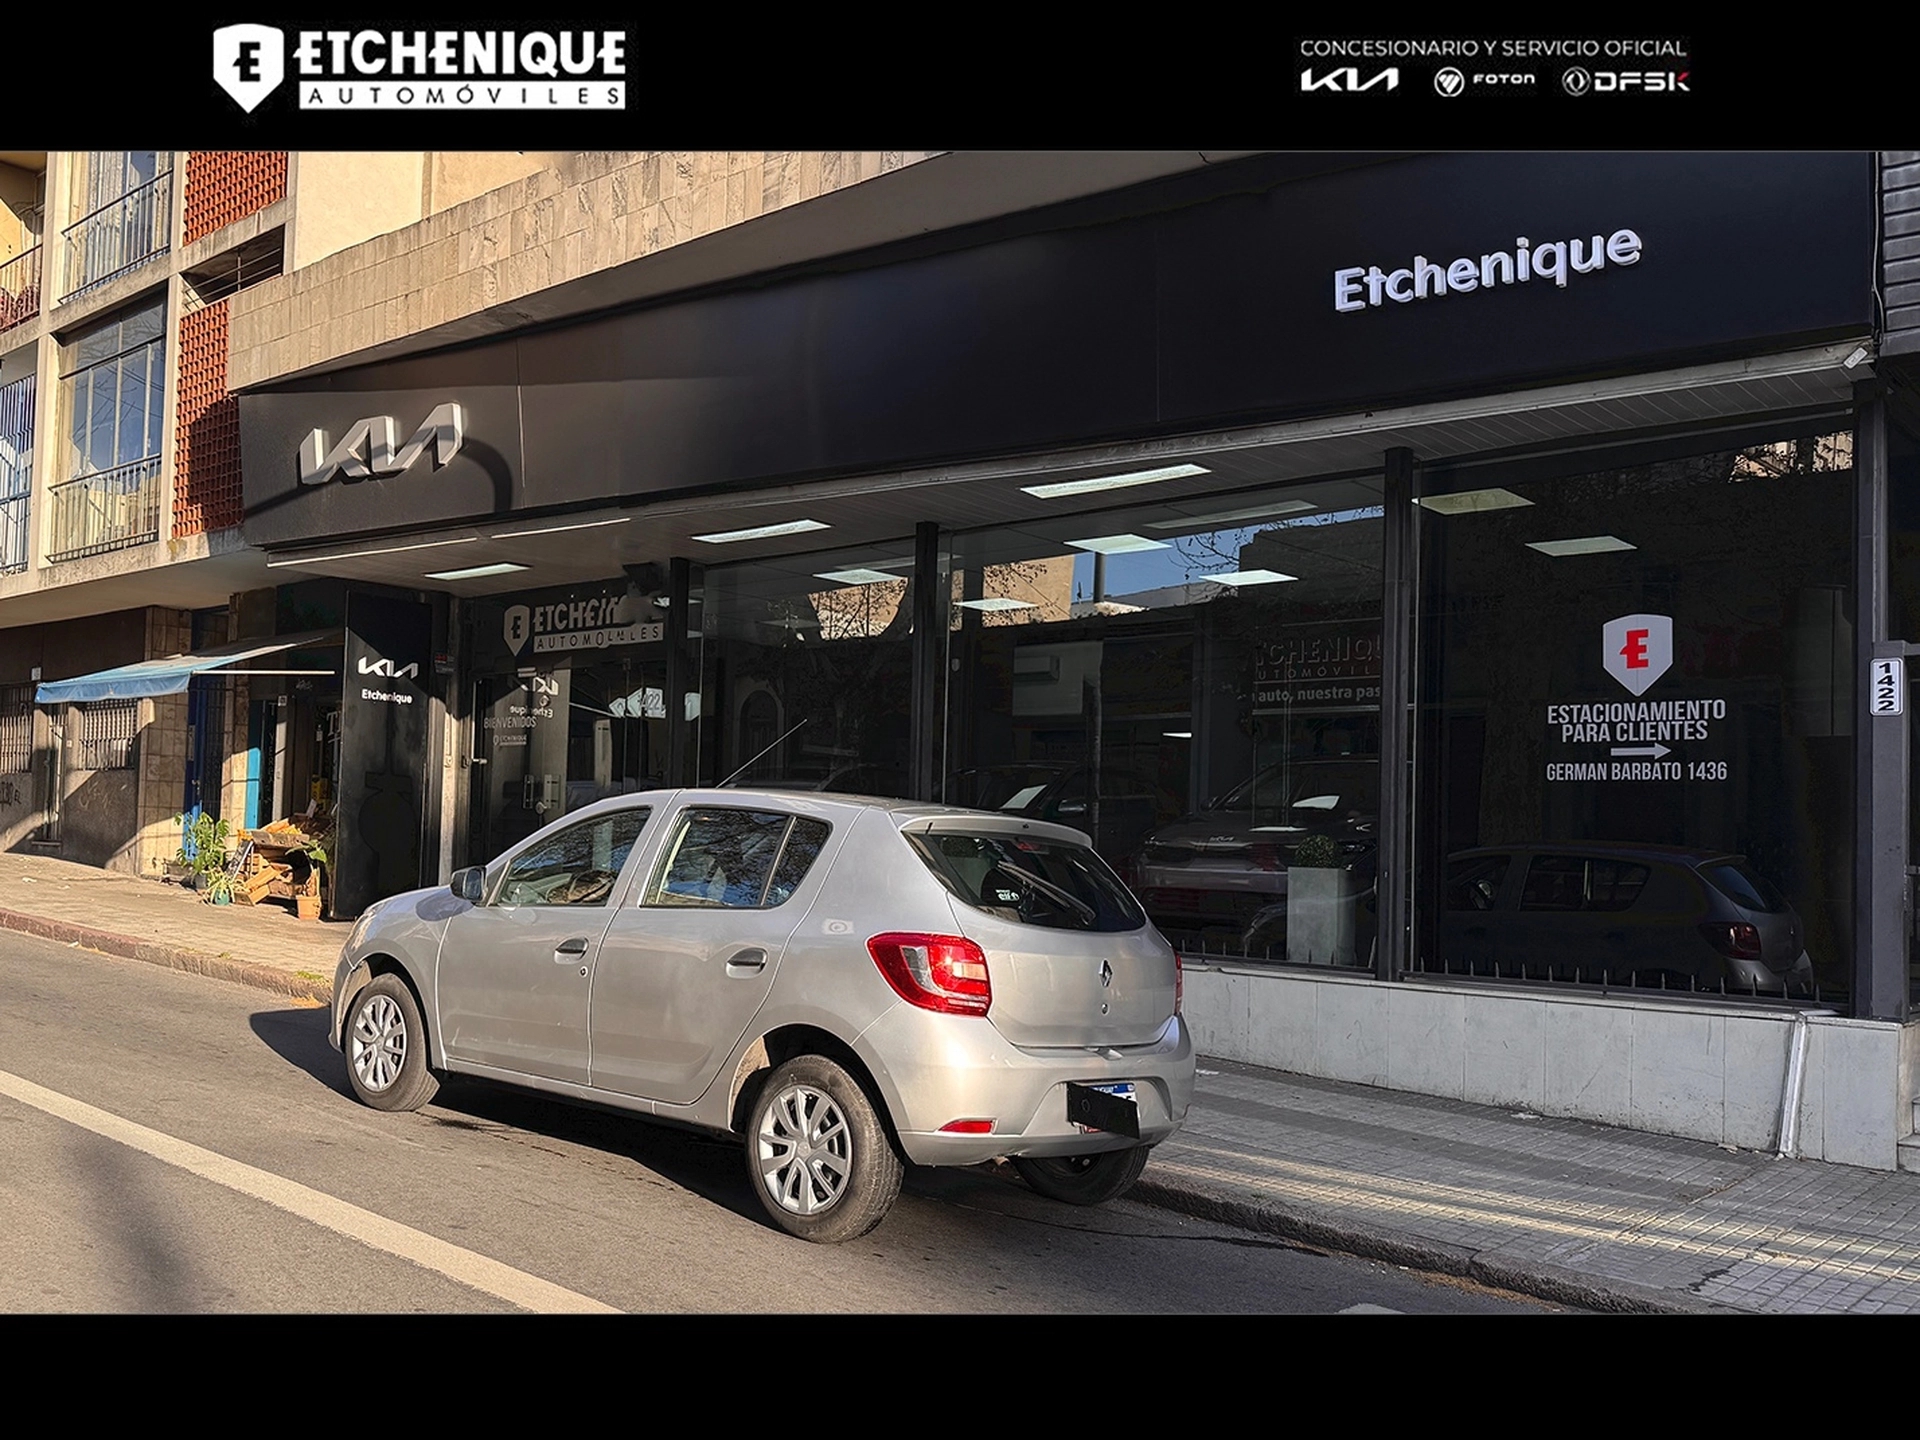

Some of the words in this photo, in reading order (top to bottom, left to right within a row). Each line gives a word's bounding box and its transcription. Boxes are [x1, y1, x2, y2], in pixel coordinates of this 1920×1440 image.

[1334, 228, 1642, 312] Etchenique
[299, 402, 462, 485] KIA
[358, 656, 418, 679] KIA
[361, 688, 412, 704] Etchenique
[1258, 688, 1293, 703] auto,
[1297, 686, 1352, 700] nuestra
[1877, 662, 1895, 711] 1422
[484, 716, 538, 728] BIENVENIDOS
[1547, 699, 1726, 724] ESTACIONAMIENTO
[1562, 723, 1611, 742] PARA
[1615, 720, 1708, 742] CLIENTES
[1546, 762, 1607, 781] GERMAN
[1611, 762, 1682, 781] BARBATO
[1687, 761, 1728, 780] 1436
